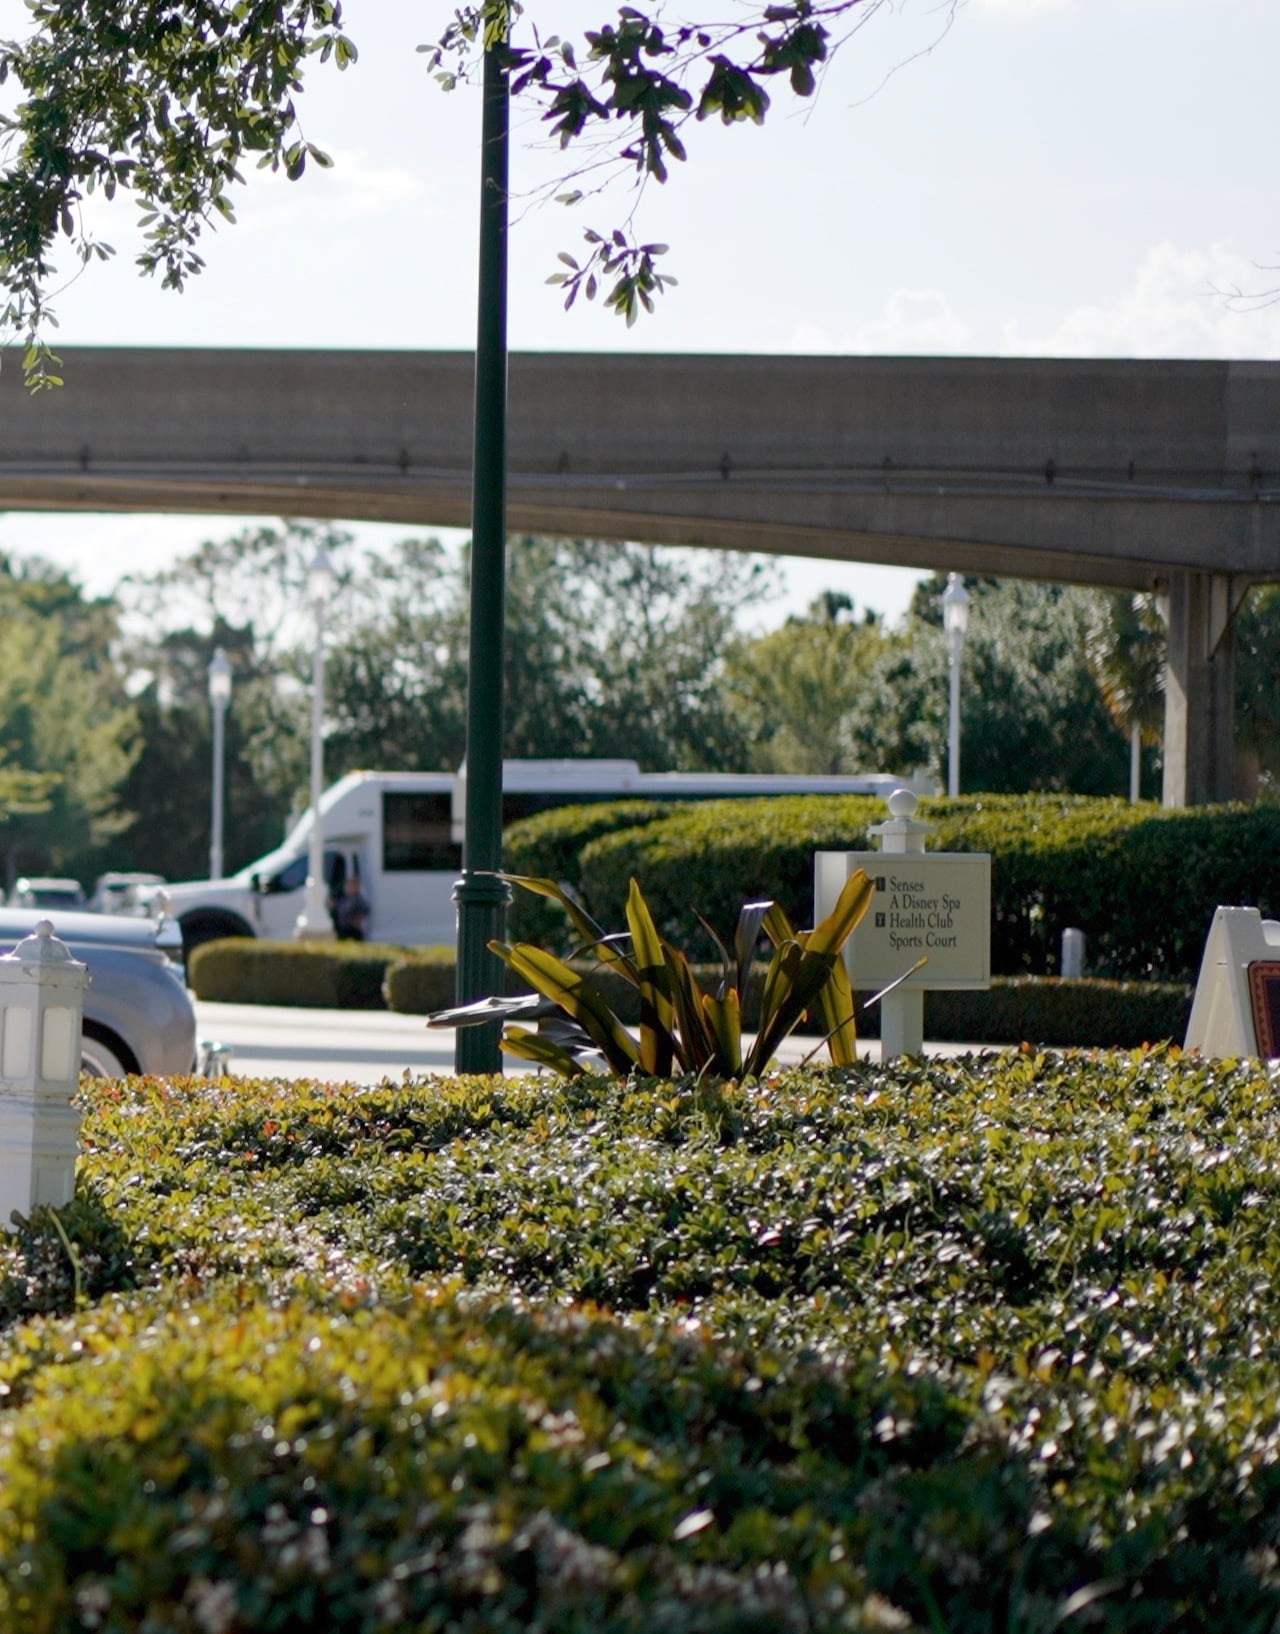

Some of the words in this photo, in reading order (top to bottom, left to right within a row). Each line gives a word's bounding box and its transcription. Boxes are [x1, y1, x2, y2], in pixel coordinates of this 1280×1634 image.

[889, 876, 925, 892] Senses
[890, 894, 899, 909] A
[902, 893, 939, 912] Disney
[942, 893, 961, 913] Spa
[889, 912, 925, 928] Health
[927, 912, 954, 928] Club
[889, 931, 923, 951] Sports
[925, 931, 957, 947] Court
